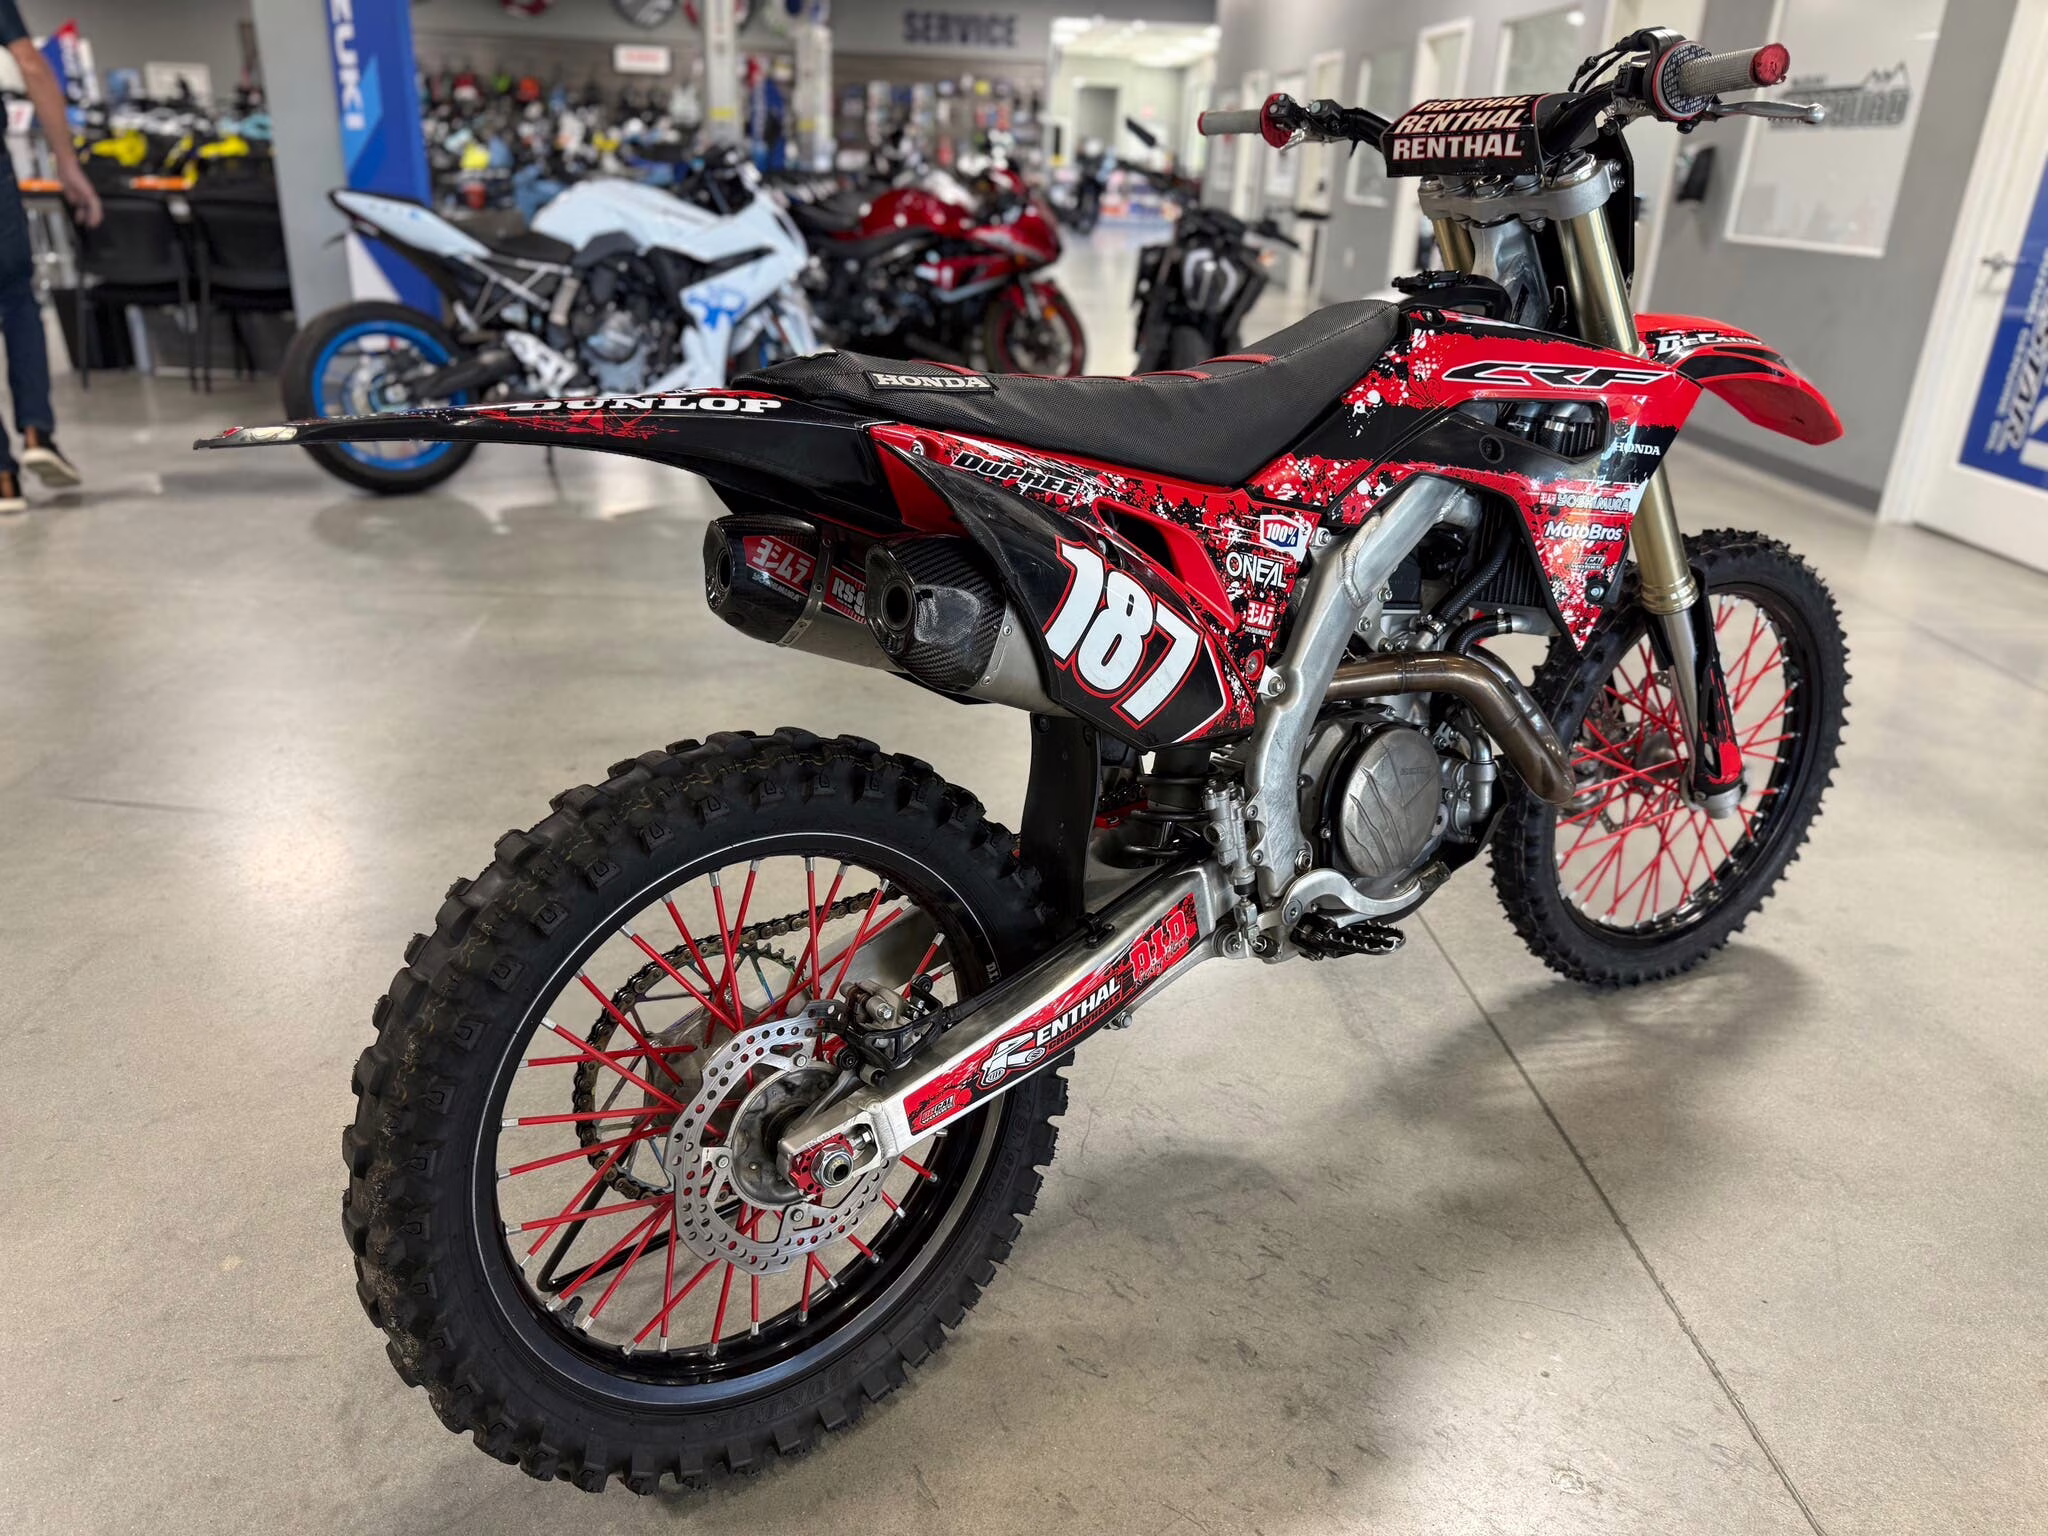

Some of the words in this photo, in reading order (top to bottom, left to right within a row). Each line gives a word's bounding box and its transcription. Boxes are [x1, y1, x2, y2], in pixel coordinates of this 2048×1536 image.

[902, 9, 1017, 47] SERVICE
[1416, 95, 1532, 113] RENTHAL
[1394, 107, 1527, 135] RENTHAL
[1392, 133, 1523, 161] RENTHAL
[871, 373, 992, 388] HONDA
[1442, 359, 1675, 390] CRF
[508, 397, 783, 413] DUNLOP
[1616, 442, 1661, 456] HONDA
[1557, 493, 1630, 512] YOSHIMURA
[1265, 521, 1298, 546] 100%
[1544, 521, 1623, 541] MotoBros
[1044, 542, 1201, 722] 187
